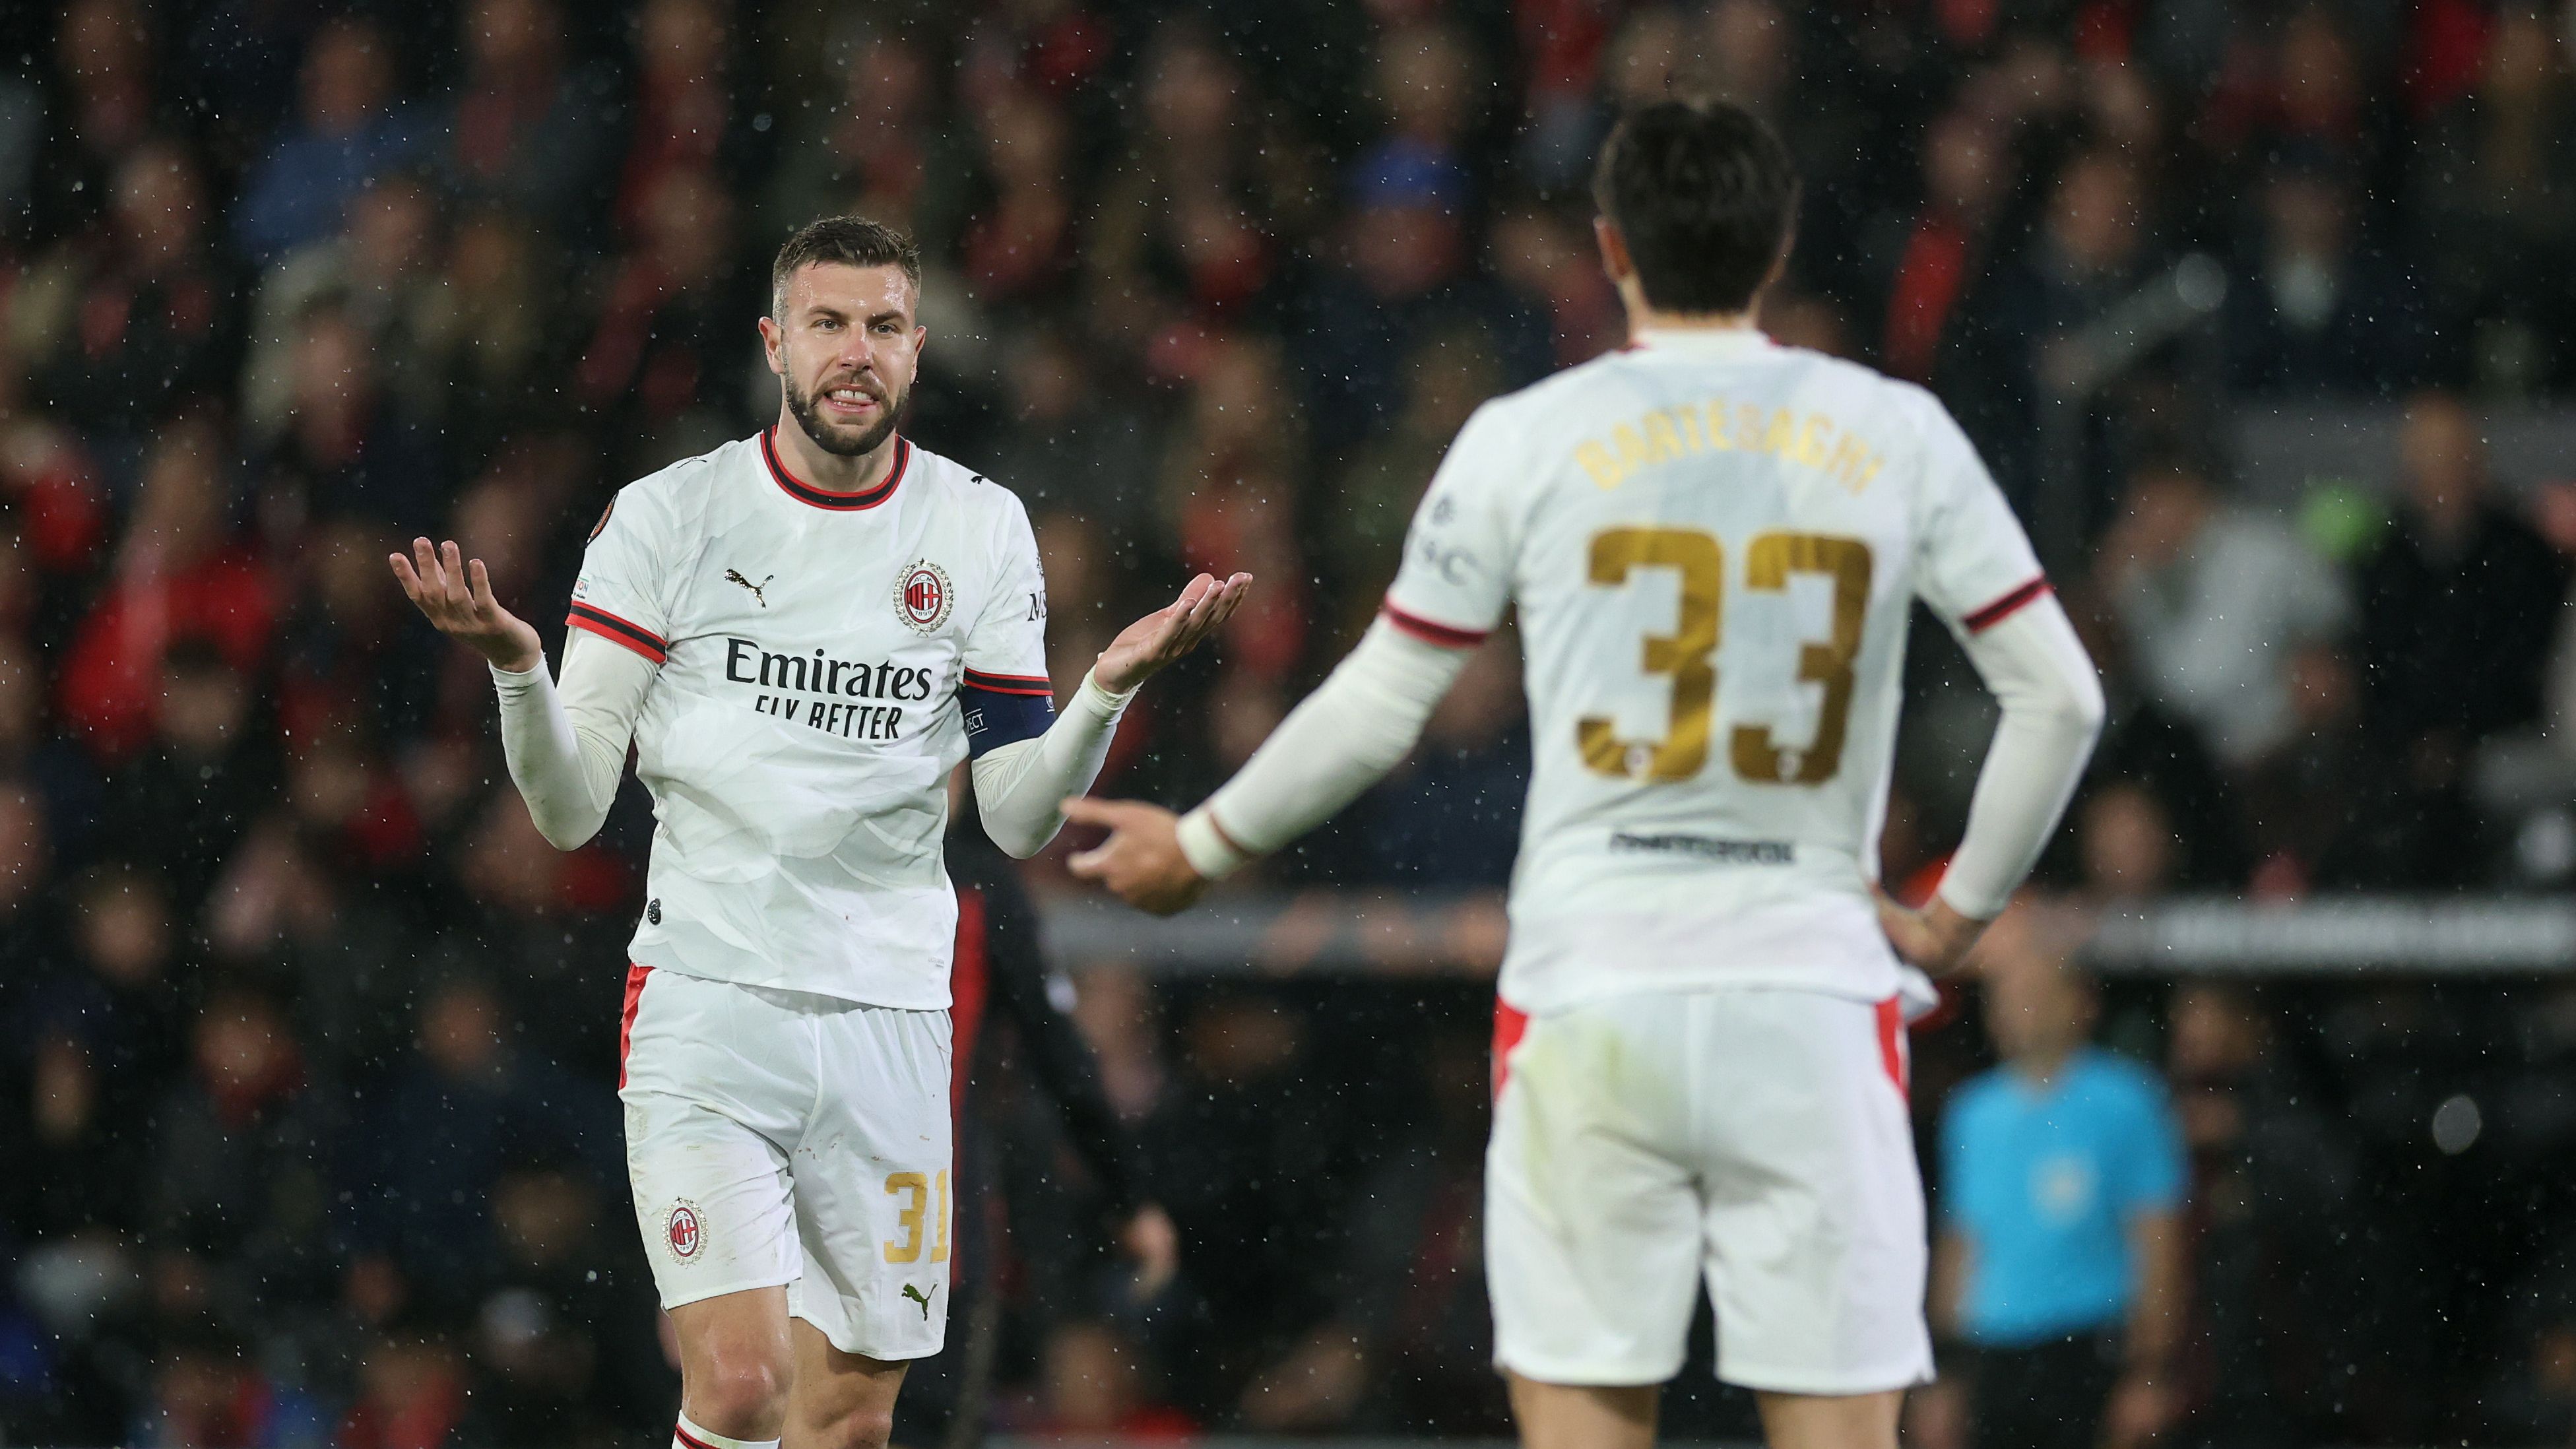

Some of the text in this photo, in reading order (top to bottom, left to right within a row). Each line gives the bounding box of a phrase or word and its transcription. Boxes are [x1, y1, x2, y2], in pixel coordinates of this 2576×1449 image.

[1575, 397, 1885, 496] BARTESAGHI
[913, 575, 934, 584] ACM
[726, 637, 932, 701] Emirates
[1576, 527, 1873, 787] 33
[808, 702, 902, 739] BETTER
[884, 1169, 948, 1264] 31
